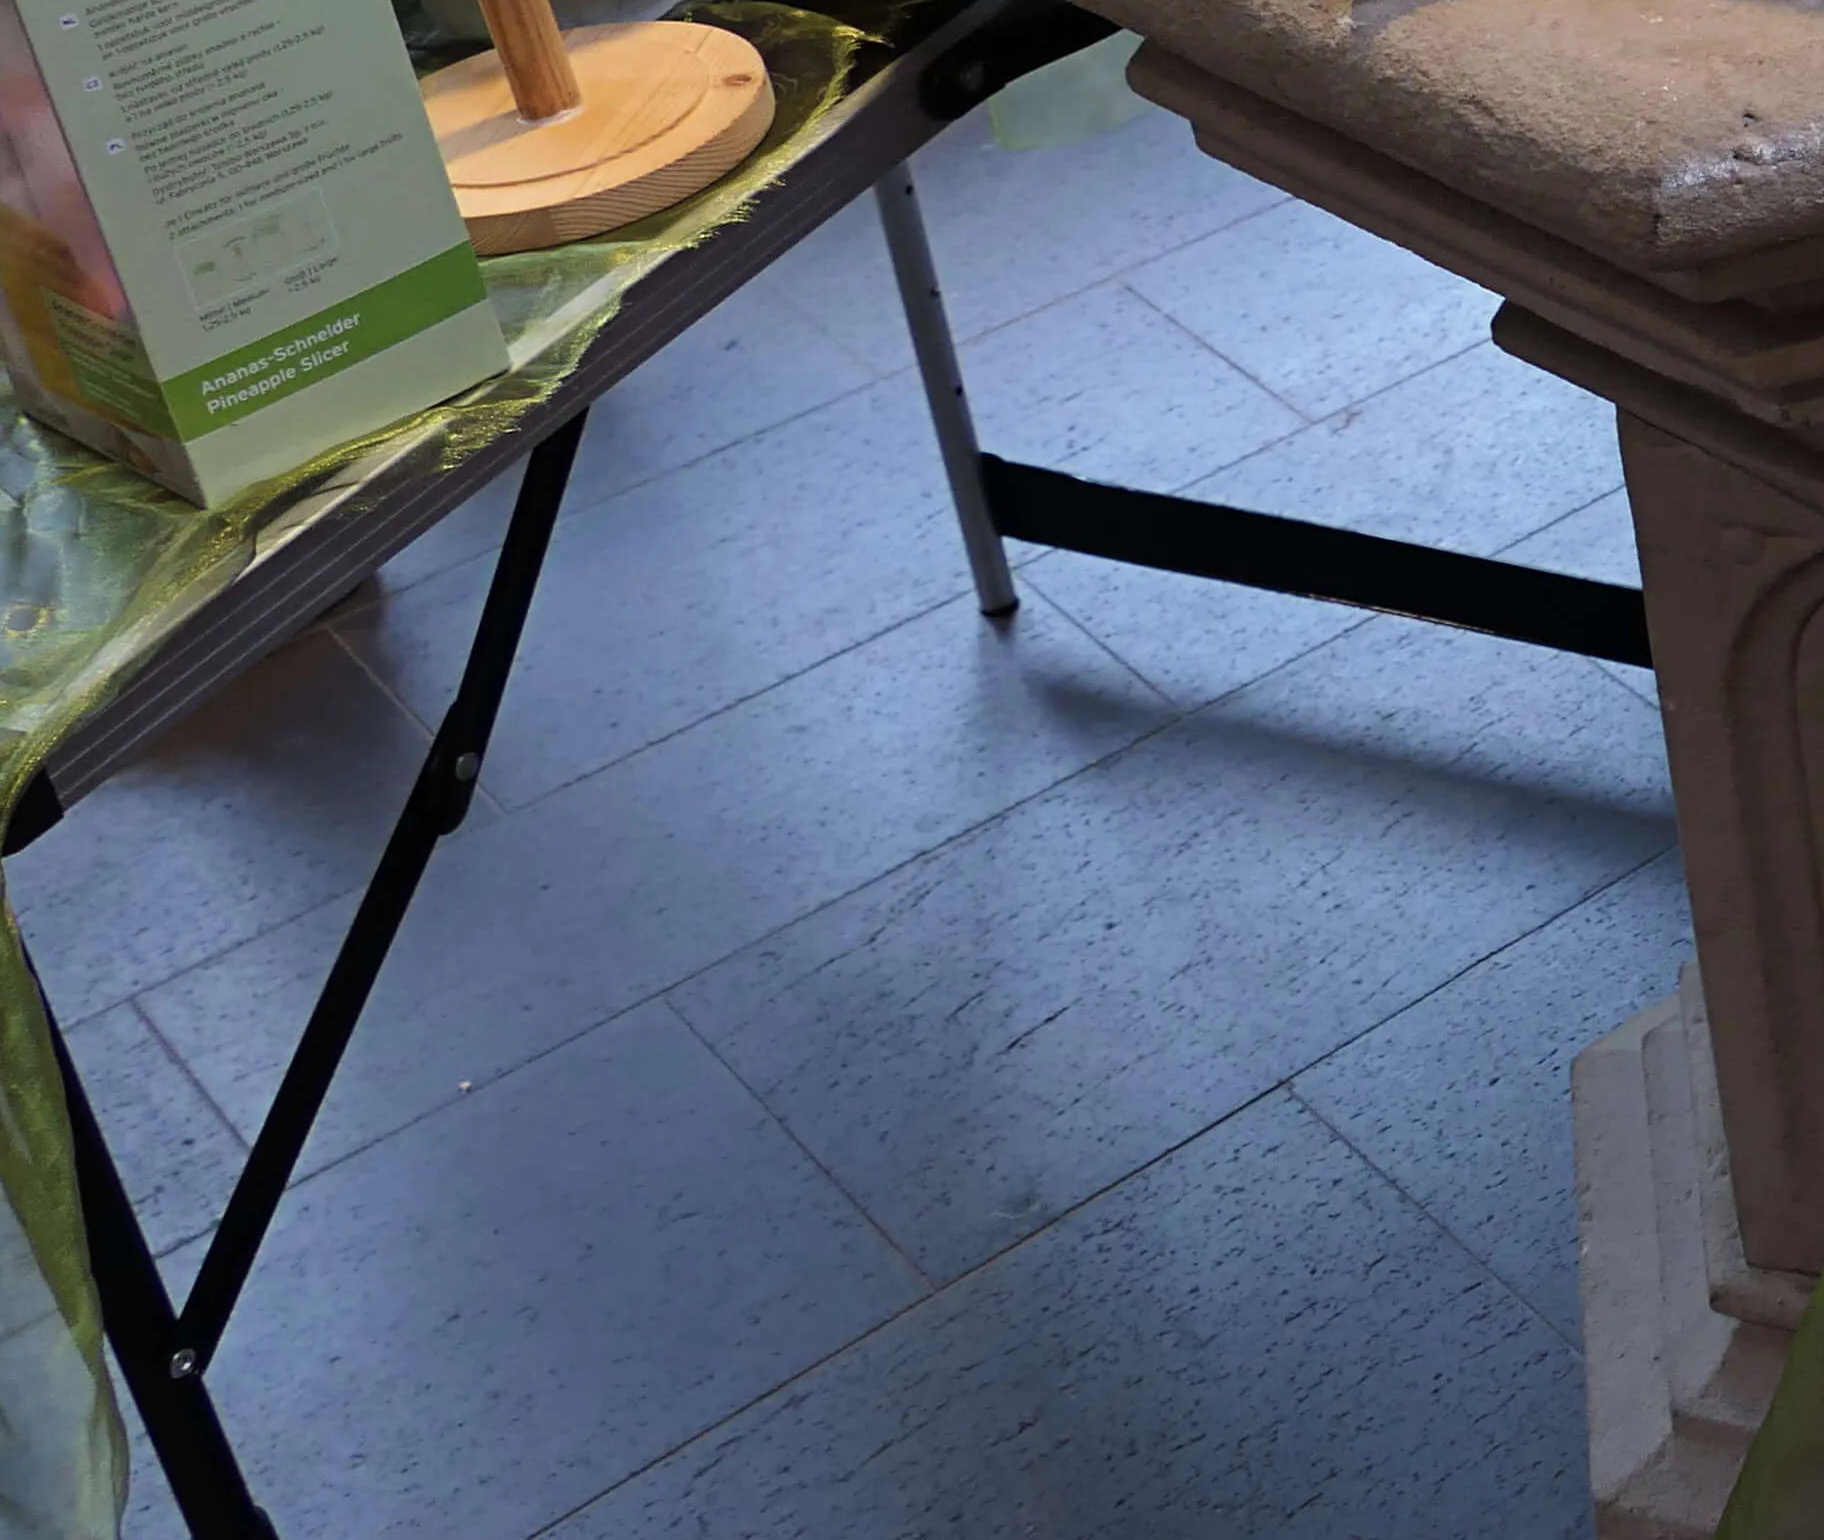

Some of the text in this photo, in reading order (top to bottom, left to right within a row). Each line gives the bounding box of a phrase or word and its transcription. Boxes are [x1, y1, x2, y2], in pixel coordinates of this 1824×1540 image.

[199, 310, 363, 398] Ananas-Schneider
[205, 336, 353, 419] Pineapple Slicer
